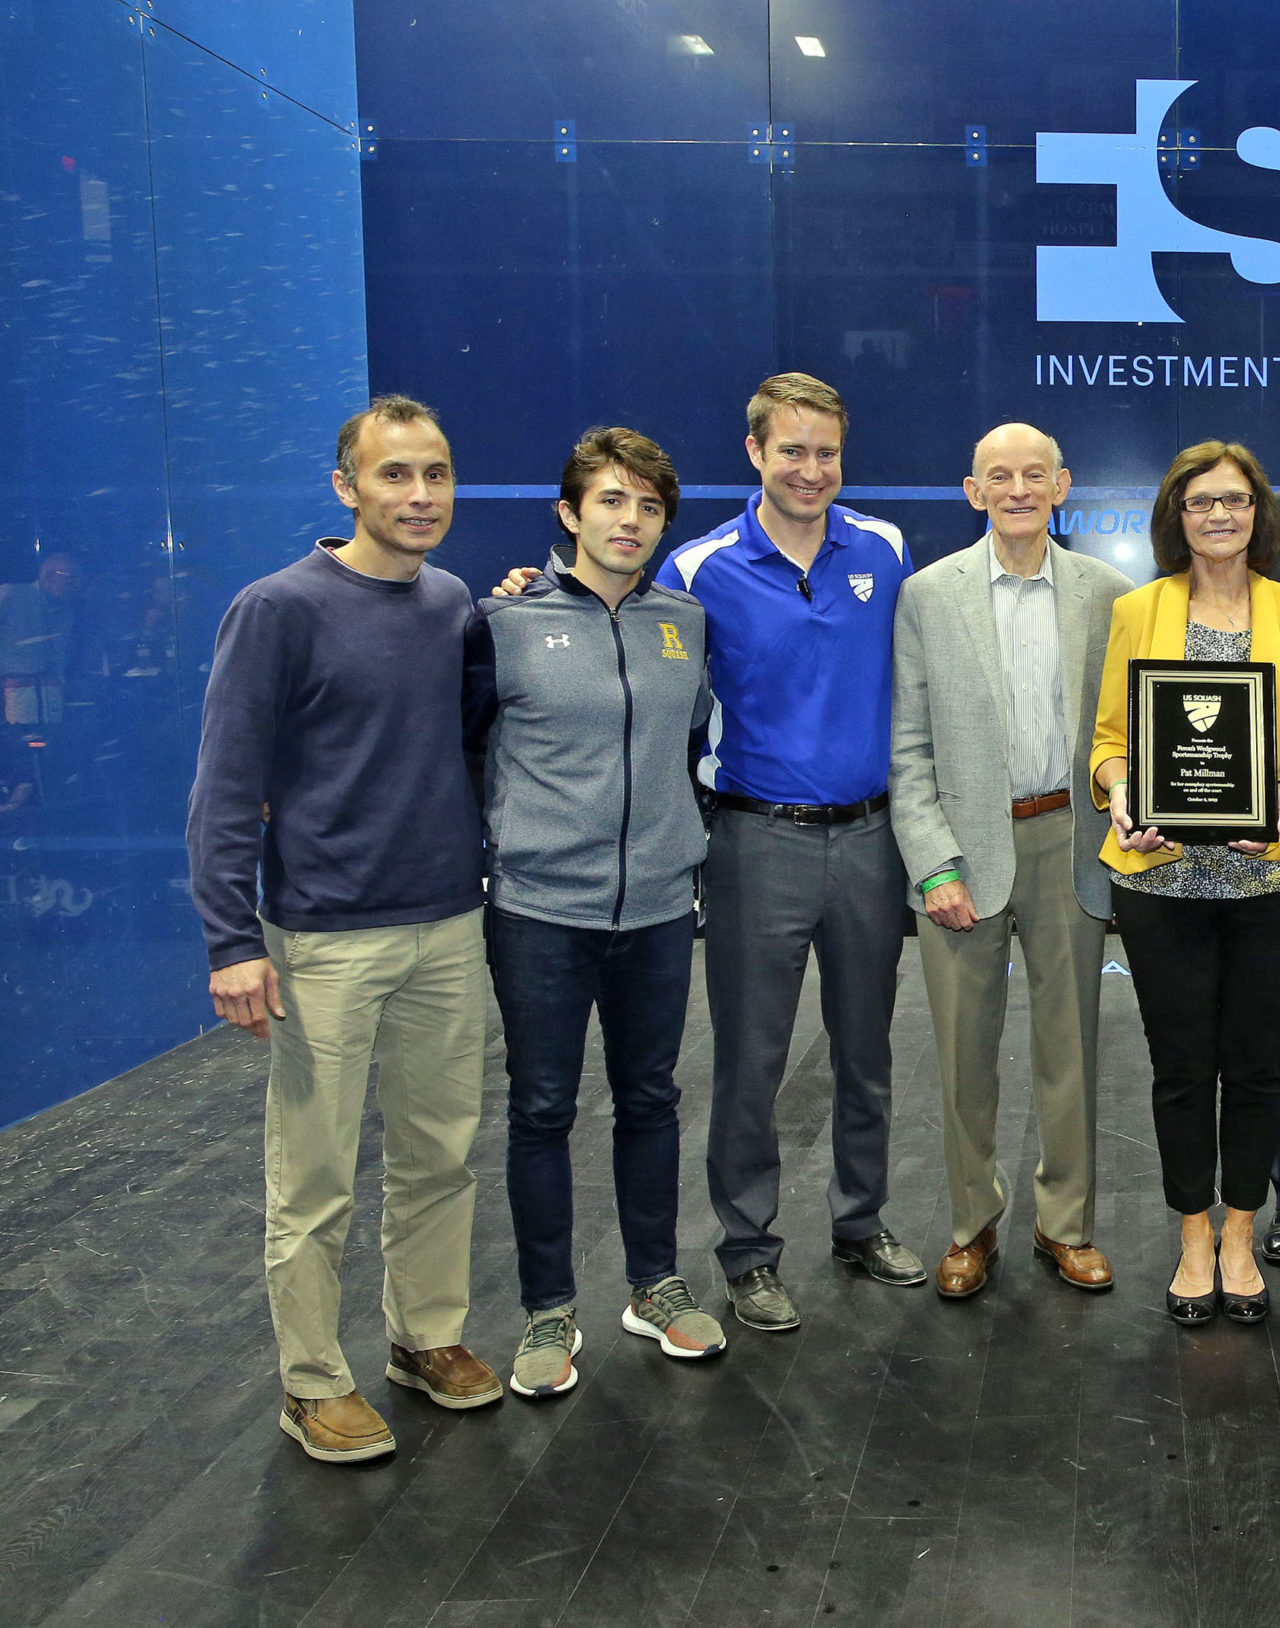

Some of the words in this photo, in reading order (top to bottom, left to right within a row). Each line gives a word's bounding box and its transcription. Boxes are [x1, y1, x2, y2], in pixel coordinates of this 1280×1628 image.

[658, 622, 683, 650] R
[1212, 752, 1233, 760] Trophy
[1180, 768, 1193, 777] Pat
[1193, 769, 1225, 777] Millman
